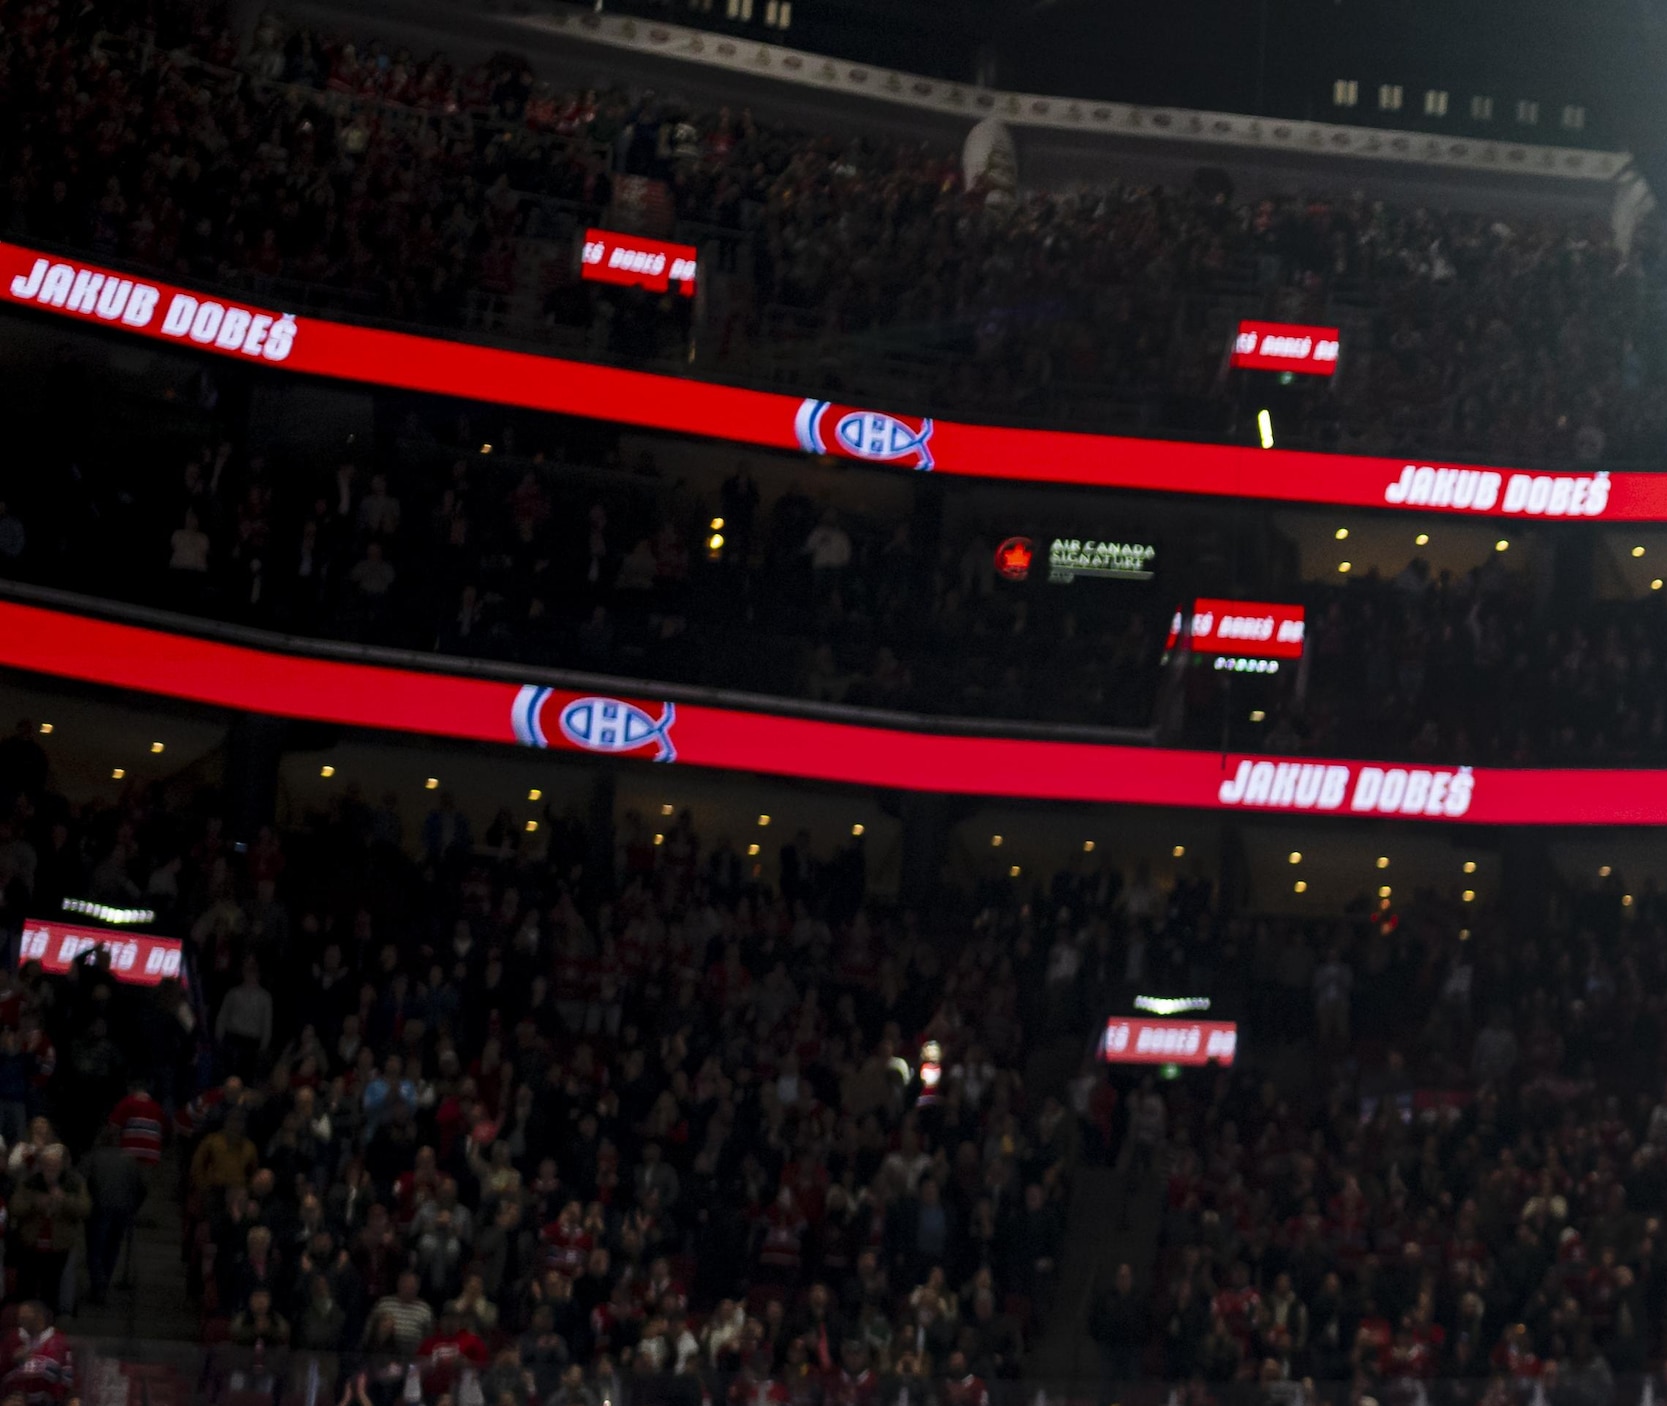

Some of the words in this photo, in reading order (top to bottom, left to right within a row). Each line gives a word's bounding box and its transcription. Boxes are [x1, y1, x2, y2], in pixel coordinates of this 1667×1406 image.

[11, 259, 159, 327] JAKUB
[162, 294, 297, 361] DOBEŠ
[1384, 465, 1501, 510] JAKUB
[1503, 471, 1611, 516] DOBEŠ
[1219, 760, 1349, 809] JAKUB
[1352, 766, 1474, 816] DOBEŠ
